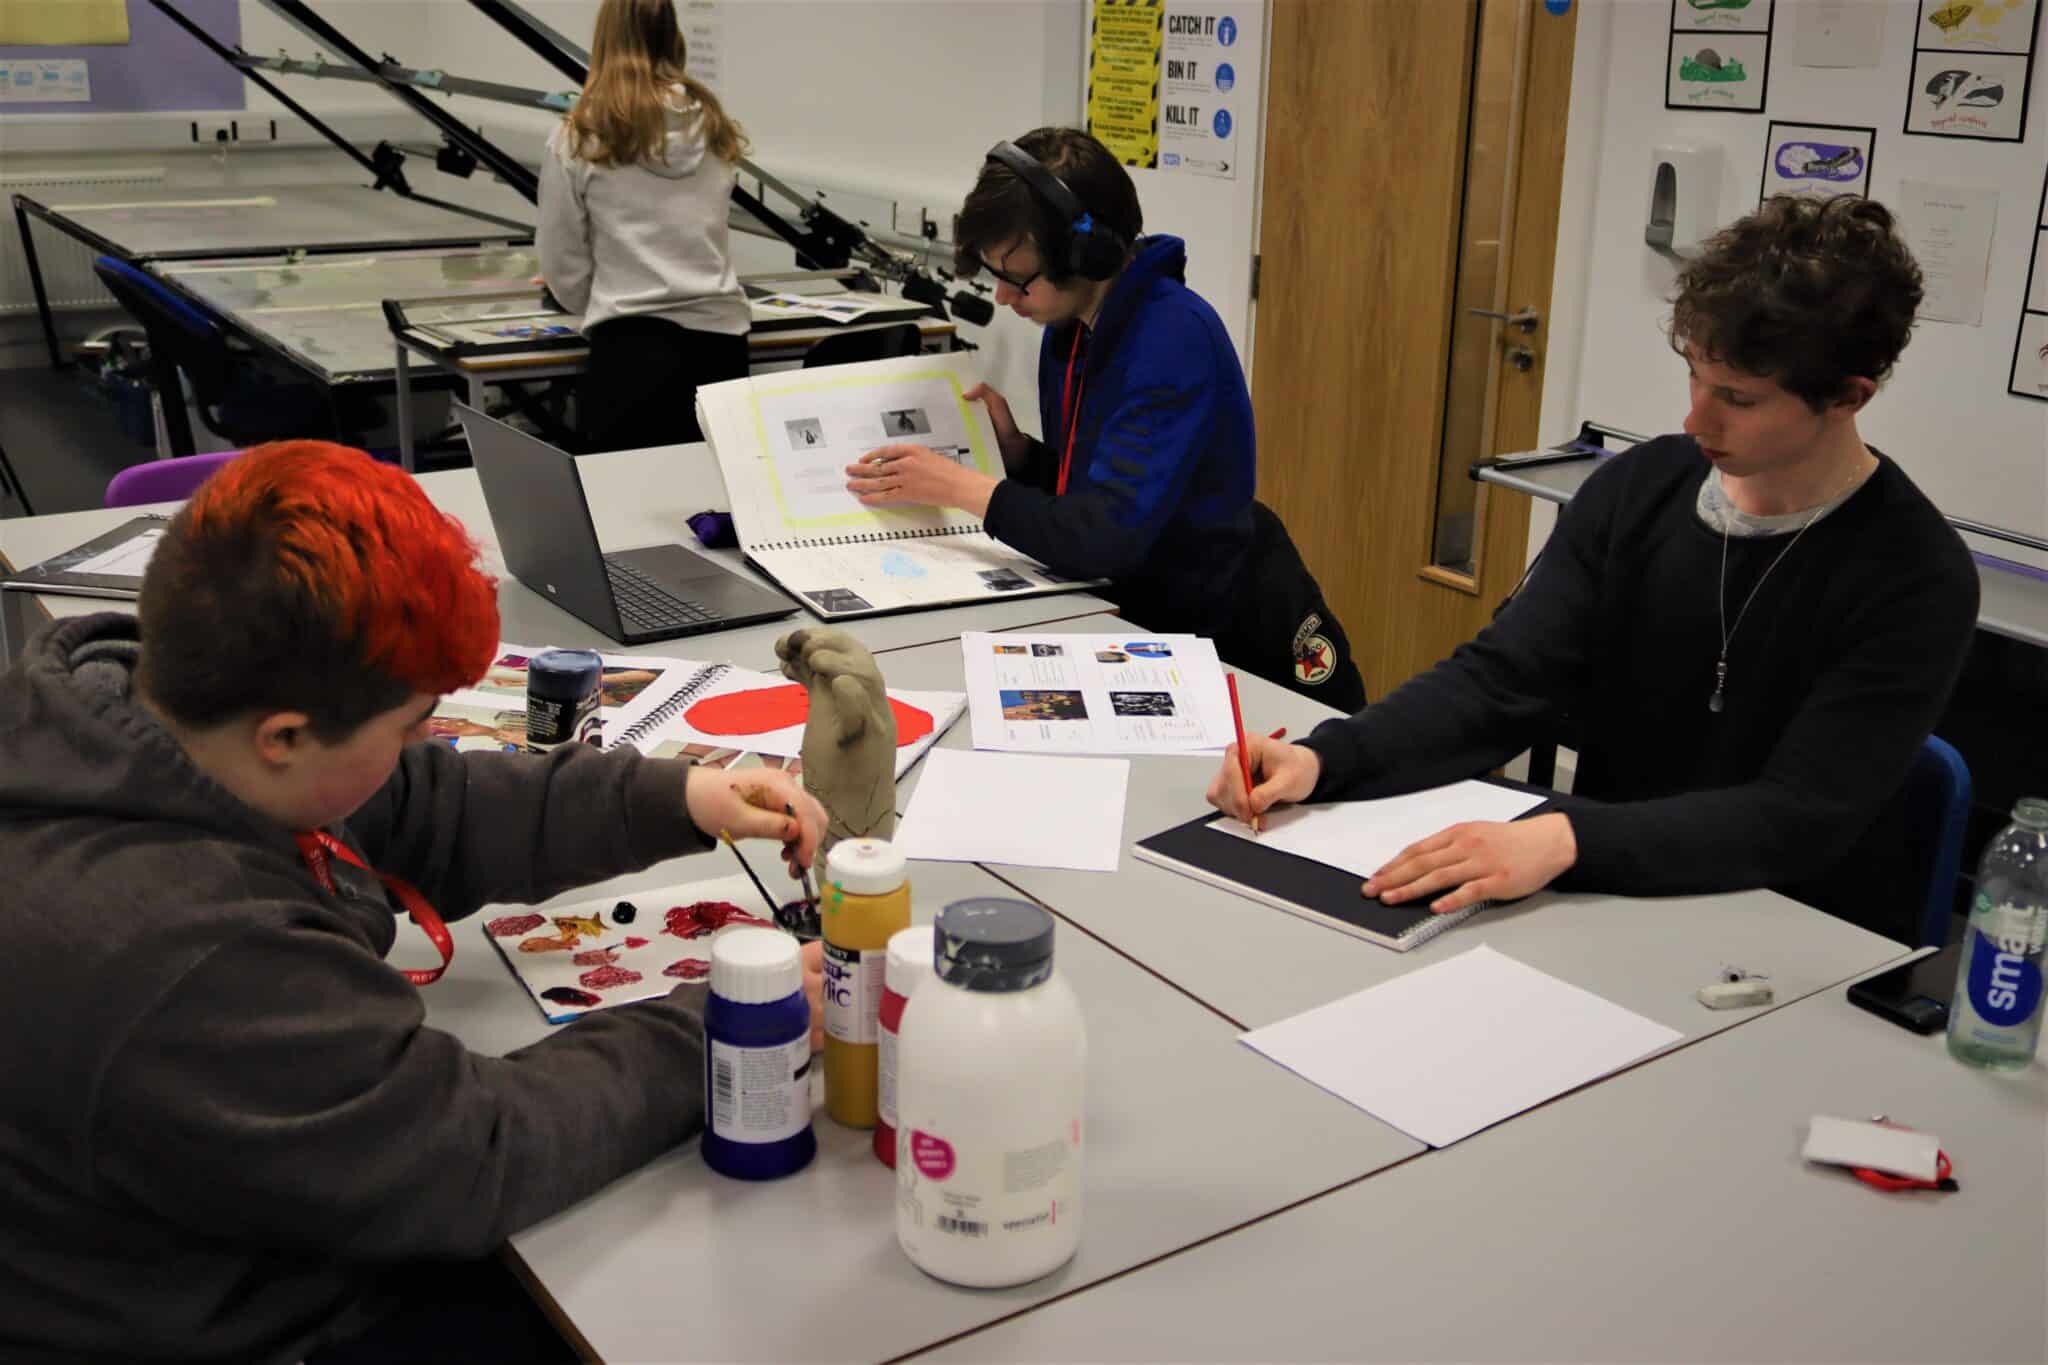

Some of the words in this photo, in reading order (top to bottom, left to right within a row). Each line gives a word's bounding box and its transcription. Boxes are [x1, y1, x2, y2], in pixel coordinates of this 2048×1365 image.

[1169, 15, 1201, 34] CATCH
[1205, 16, 1216, 34] IT
[1168, 60, 1184, 80] BIN
[1187, 61, 1197, 80] IT
[1166, 104, 1186, 125] KILL
[1189, 107, 1199, 126] IT
